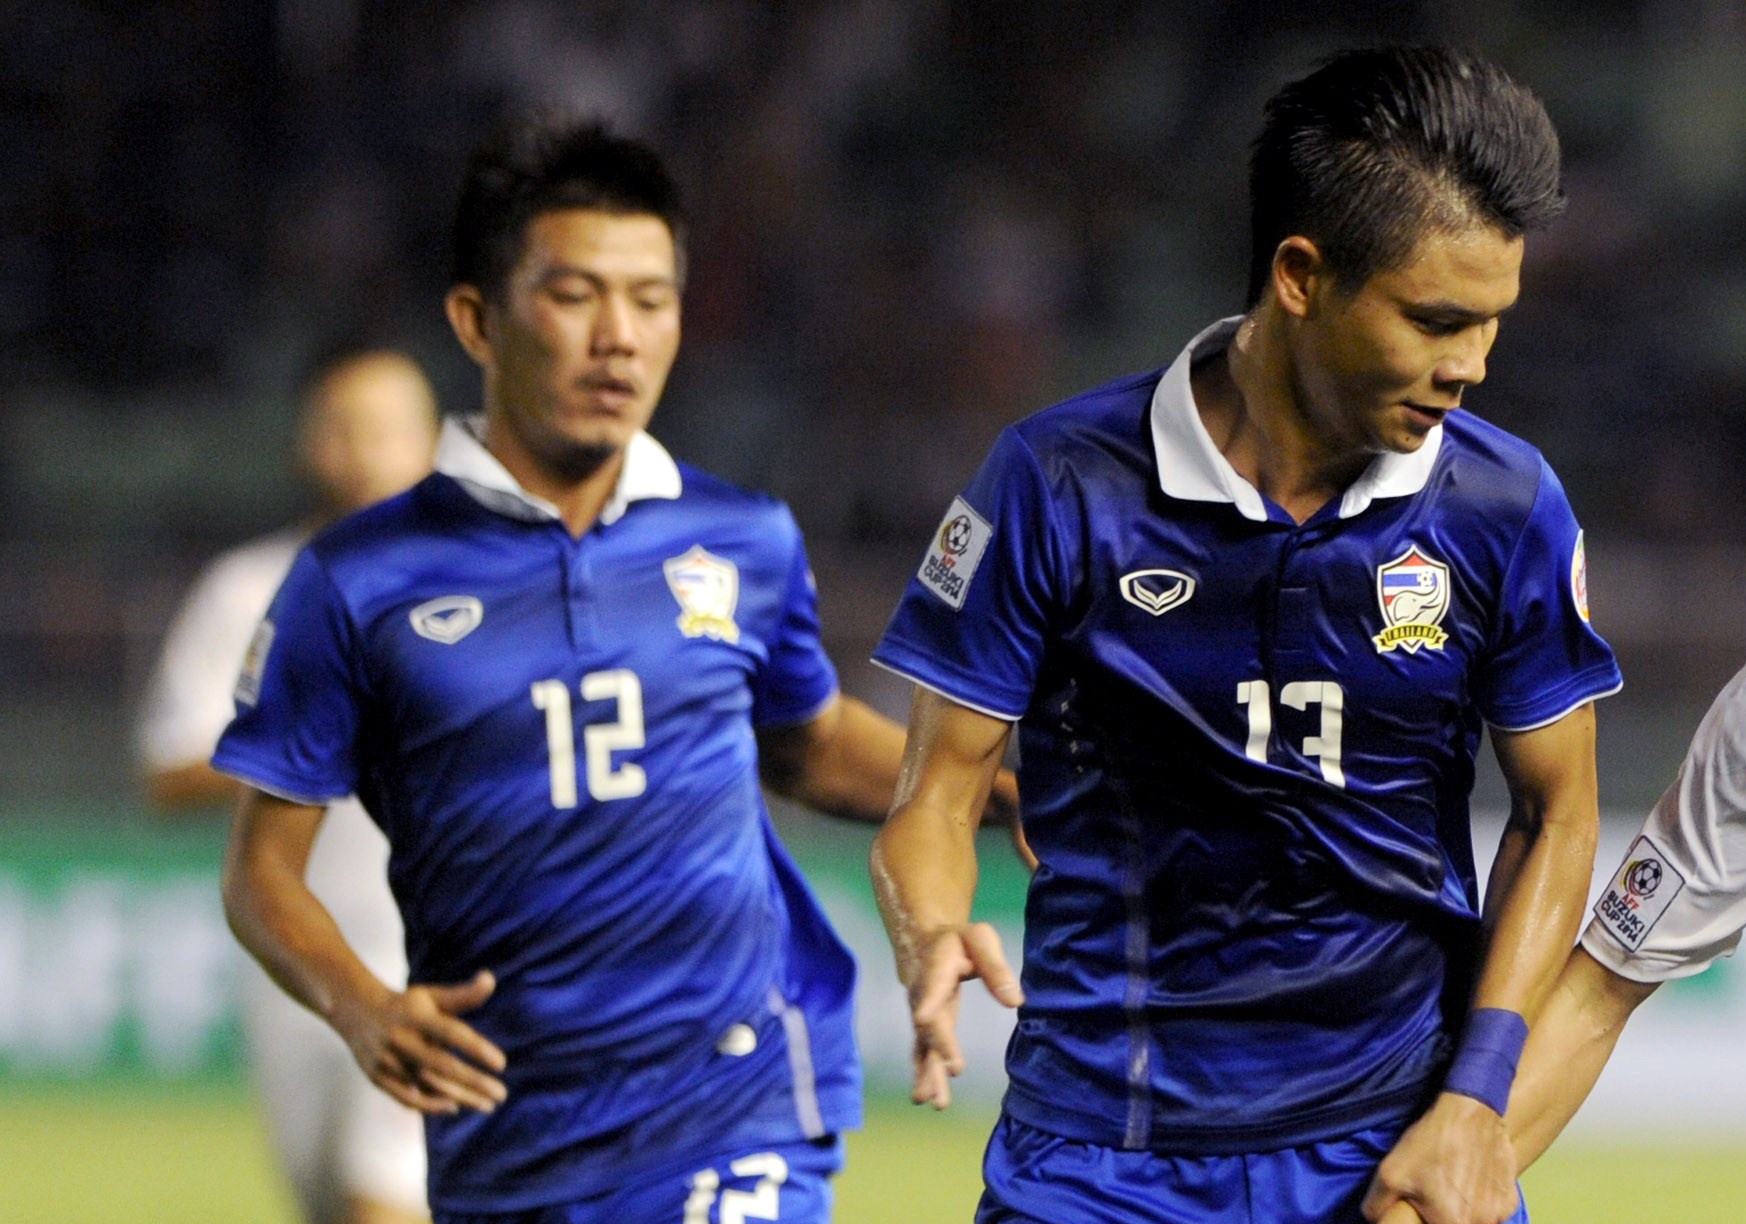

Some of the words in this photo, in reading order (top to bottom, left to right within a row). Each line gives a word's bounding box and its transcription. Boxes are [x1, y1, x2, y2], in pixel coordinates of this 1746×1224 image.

[531, 668, 647, 809] 12
[1237, 680, 1346, 788] 13
[1601, 900, 1620, 922] CUP
[1616, 920, 1639, 943] 2014
[1607, 890, 1645, 933] SUZUKI
